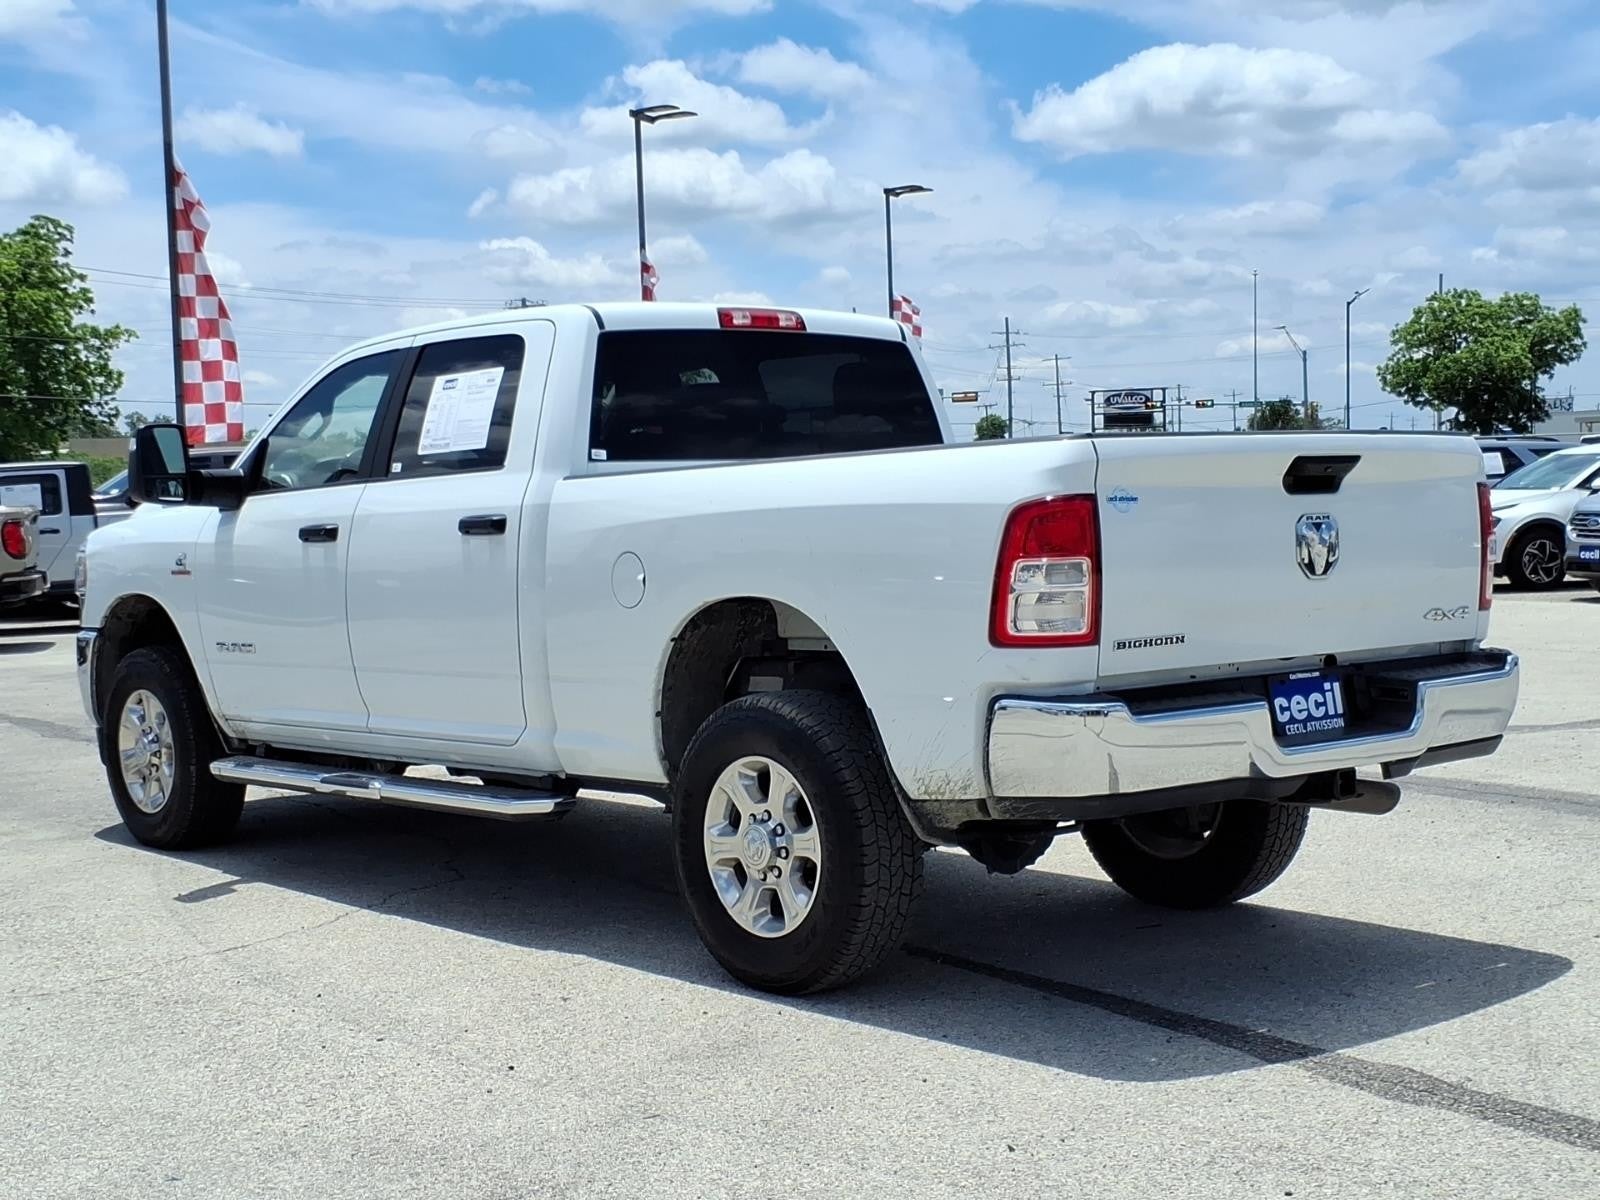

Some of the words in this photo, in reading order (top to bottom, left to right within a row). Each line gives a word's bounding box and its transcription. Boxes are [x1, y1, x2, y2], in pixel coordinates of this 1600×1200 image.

[1110, 392, 1146, 404] UVALCO
[1580, 549, 1600, 559] cecil
[1116, 635, 1185, 650] BIGHORN
[1274, 682, 1344, 722] cecil
[1286, 723, 1306, 735] CECIL
[1307, 717, 1345, 732] ATKISSION
